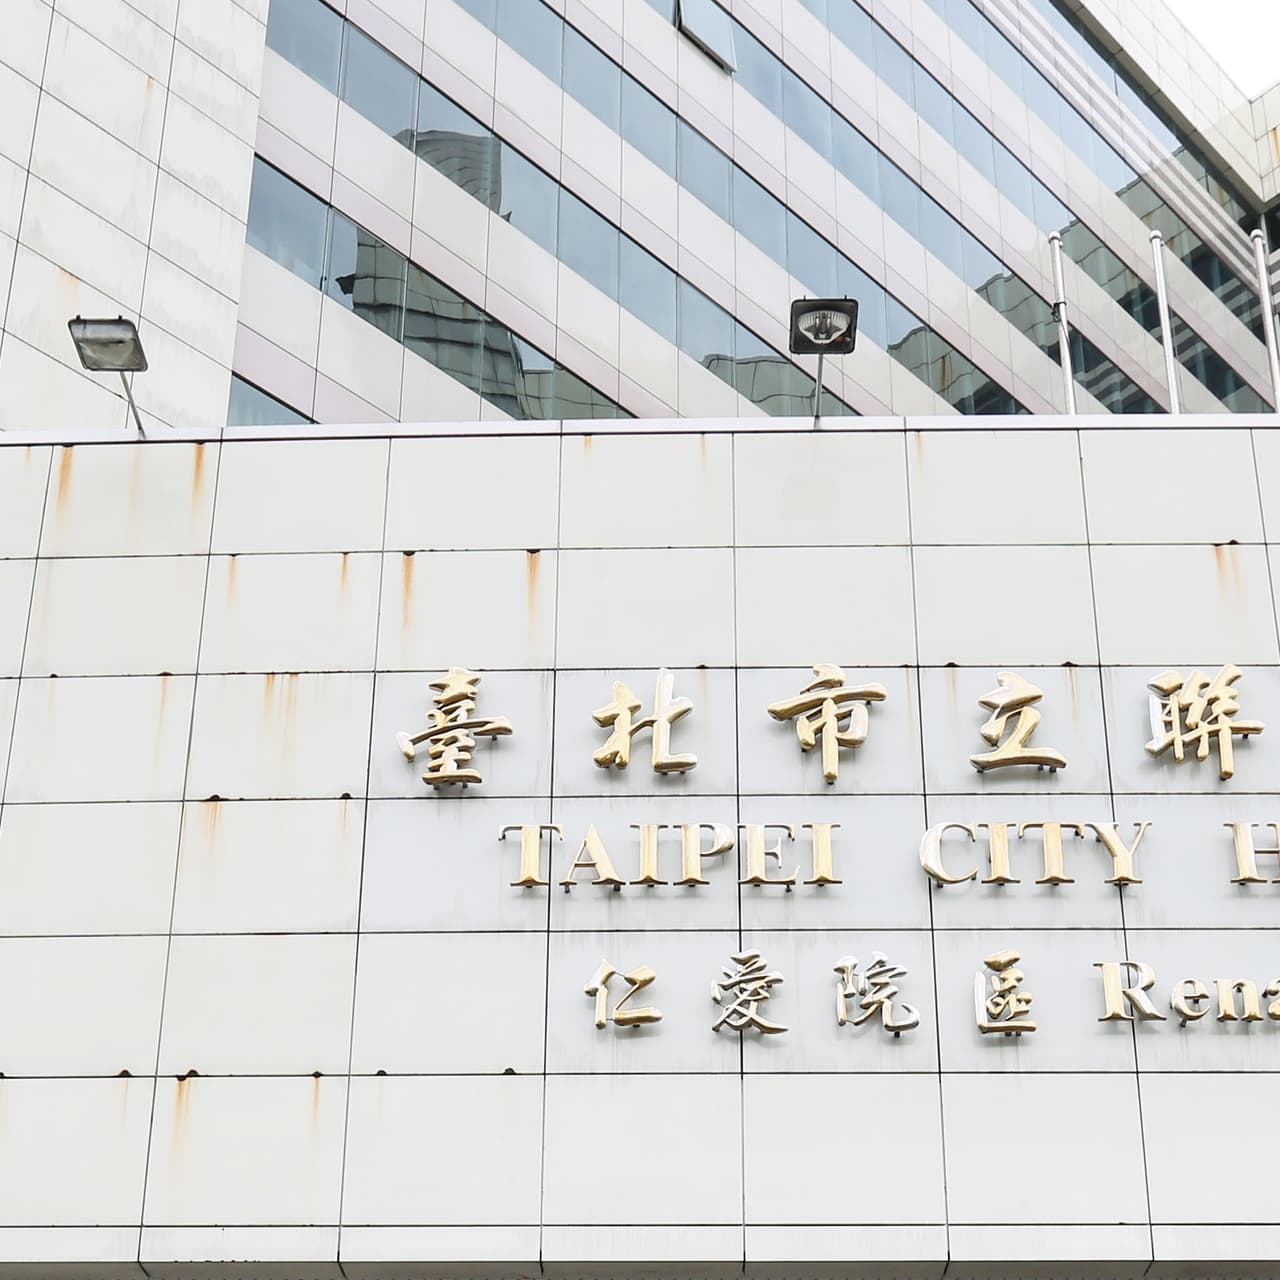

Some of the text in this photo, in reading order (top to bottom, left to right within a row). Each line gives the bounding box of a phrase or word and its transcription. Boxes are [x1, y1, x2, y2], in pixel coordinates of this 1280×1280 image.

[498, 823, 843, 887] TAIPEI
[919, 821, 1152, 885] CITY
[584, 949, 1039, 1035] 仁愛院區
